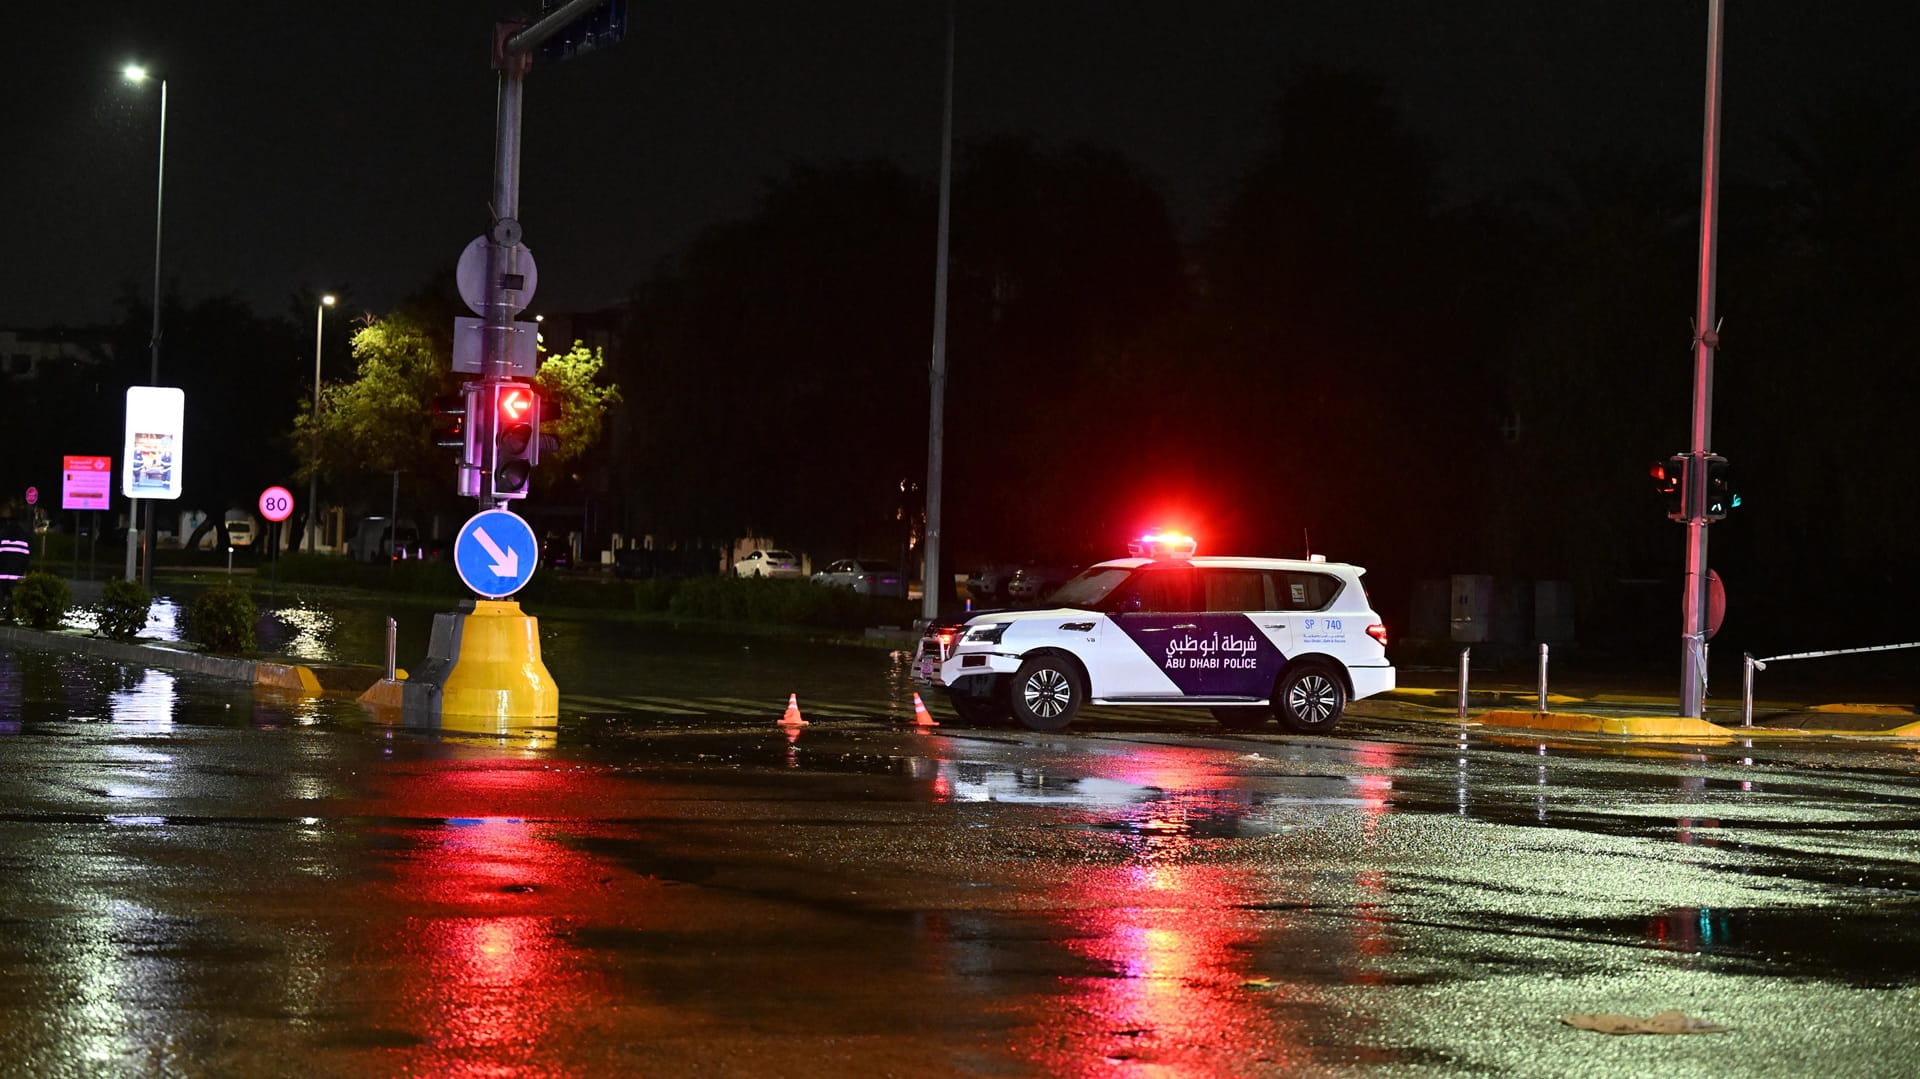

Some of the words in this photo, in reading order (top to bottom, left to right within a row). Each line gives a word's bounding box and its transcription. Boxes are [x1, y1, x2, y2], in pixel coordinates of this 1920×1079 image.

[266, 497, 287, 511] 80
[1304, 618, 1315, 630] SP
[1325, 619, 1342, 630] 740
[1221, 635, 1257, 657] شرطة
[1165, 658, 1186, 669] ABU
[1189, 658, 1220, 669] DHABI
[1223, 658, 1257, 669] POLICE
